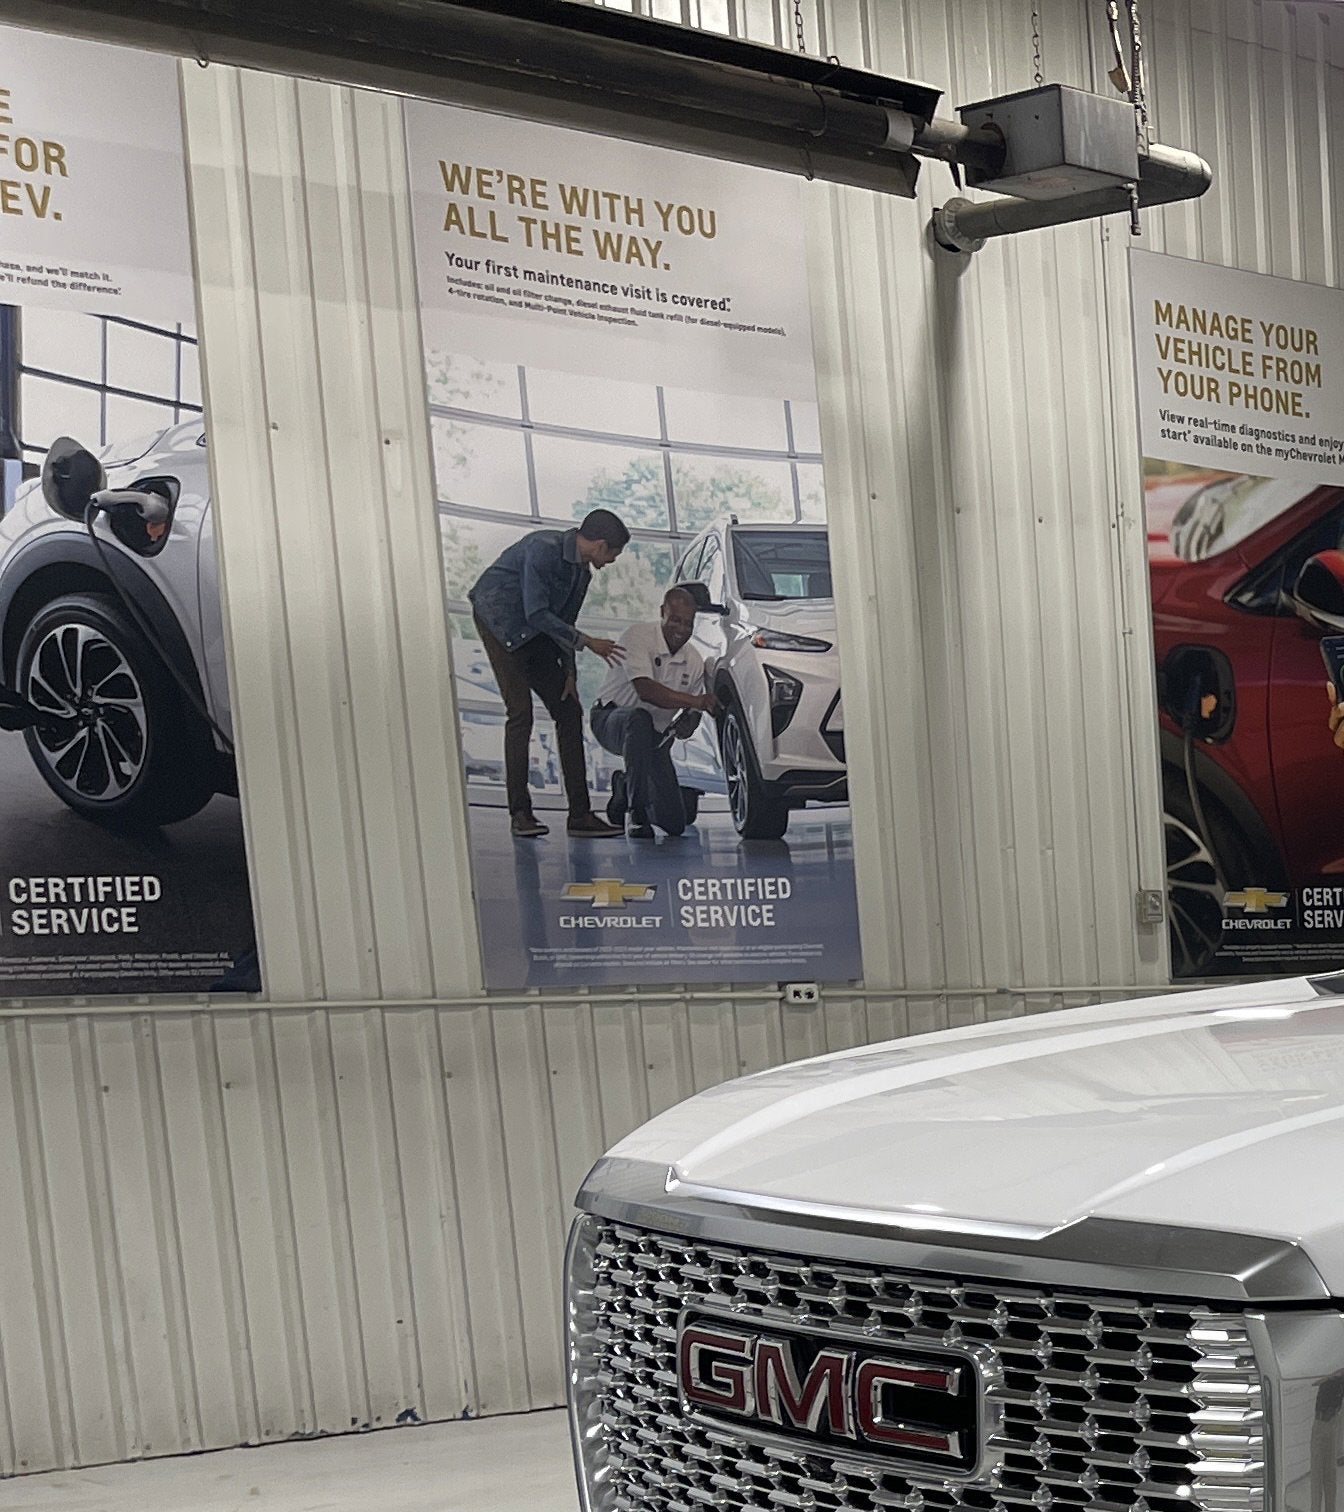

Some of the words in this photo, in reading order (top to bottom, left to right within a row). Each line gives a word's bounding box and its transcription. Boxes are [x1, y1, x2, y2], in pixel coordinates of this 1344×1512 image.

[0, 179, 62, 221] EV.
[438, 160, 549, 211] WE'RE
[558, 184, 645, 227] WITH
[654, 201, 717, 239] YOU
[443, 203, 509, 243] ALL
[517, 216, 583, 256] THE
[592, 229, 671, 271] WAY.
[17, 276, 48, 287] refund
[51, 280, 67, 289] the
[26, 265, 43, 273] and
[70, 270, 100, 281] match
[444, 251, 480, 272] Your
[485, 260, 520, 280] first
[523, 269, 618, 297] maintenance
[621, 283, 652, 301] visit
[656, 288, 668, 304] is
[1154, 300, 1254, 344] MANAGE
[1260, 321, 1319, 356] YOUR
[1155, 334, 1254, 377] VEHICLE
[1262, 355, 1322, 388] FROM
[1157, 367, 1221, 404] YOUR
[1228, 381, 1310, 418] PHONE.
[1159, 409, 1184, 424] View
[1187, 415, 1236, 434] real-time
[1239, 423, 1296, 443] diagnostics
[1298, 432, 1316, 446] and
[1319, 436, 1344, 452] enjoy
[1193, 434, 1238, 451] available
[1241, 443, 1253, 452] on
[1255, 442, 1272, 456] the
[1274, 446, 1336, 465] myChevrolet
[8, 875, 162, 904] CERTIFIED
[677, 877, 792, 901] CERTIFIED
[11, 907, 140, 935] SERVICE
[559, 916, 663, 929] CHEVROLET
[680, 904, 776, 928] SERVICE
[1221, 918, 1293, 930] CHEVROLET
[681, 1325, 963, 1458] GMC
